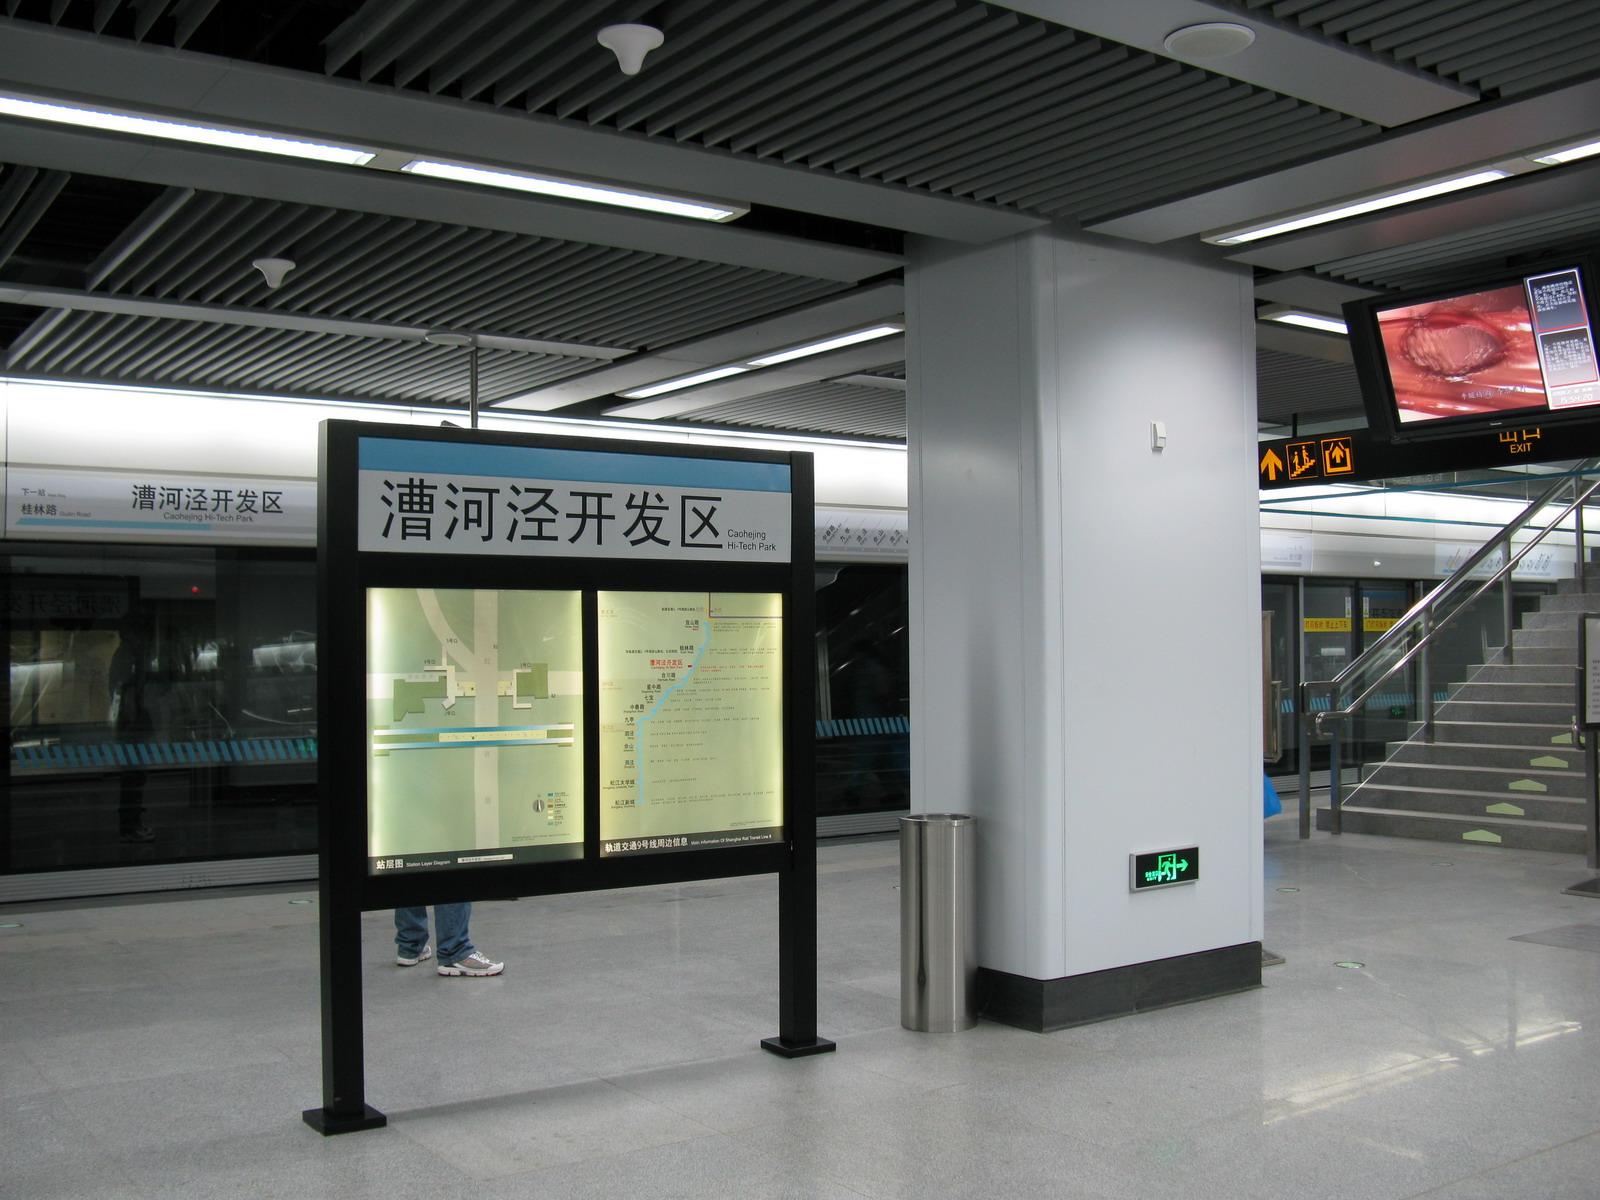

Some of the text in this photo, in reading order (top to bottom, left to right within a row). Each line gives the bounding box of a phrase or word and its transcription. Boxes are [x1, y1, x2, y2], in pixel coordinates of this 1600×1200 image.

[1510, 443, 1533, 453] EXIT
[21, 487, 46, 497] 下一站
[132, 484, 284, 514] 漕河泾开发区
[21, 503, 57, 516] 桂林路
[380, 477, 723, 548] 漕河泾开发区
[163, 512, 254, 523] Caohejing Hi-Tech Park
[727, 528, 767, 541] Caohejing
[727, 540, 777, 551] Hi-Tech Park
[650, 659, 683, 667] 河泾开发区
[604, 837, 689, 853] 轨道交通9号线周边信息
[376, 858, 404, 870] 站层图
